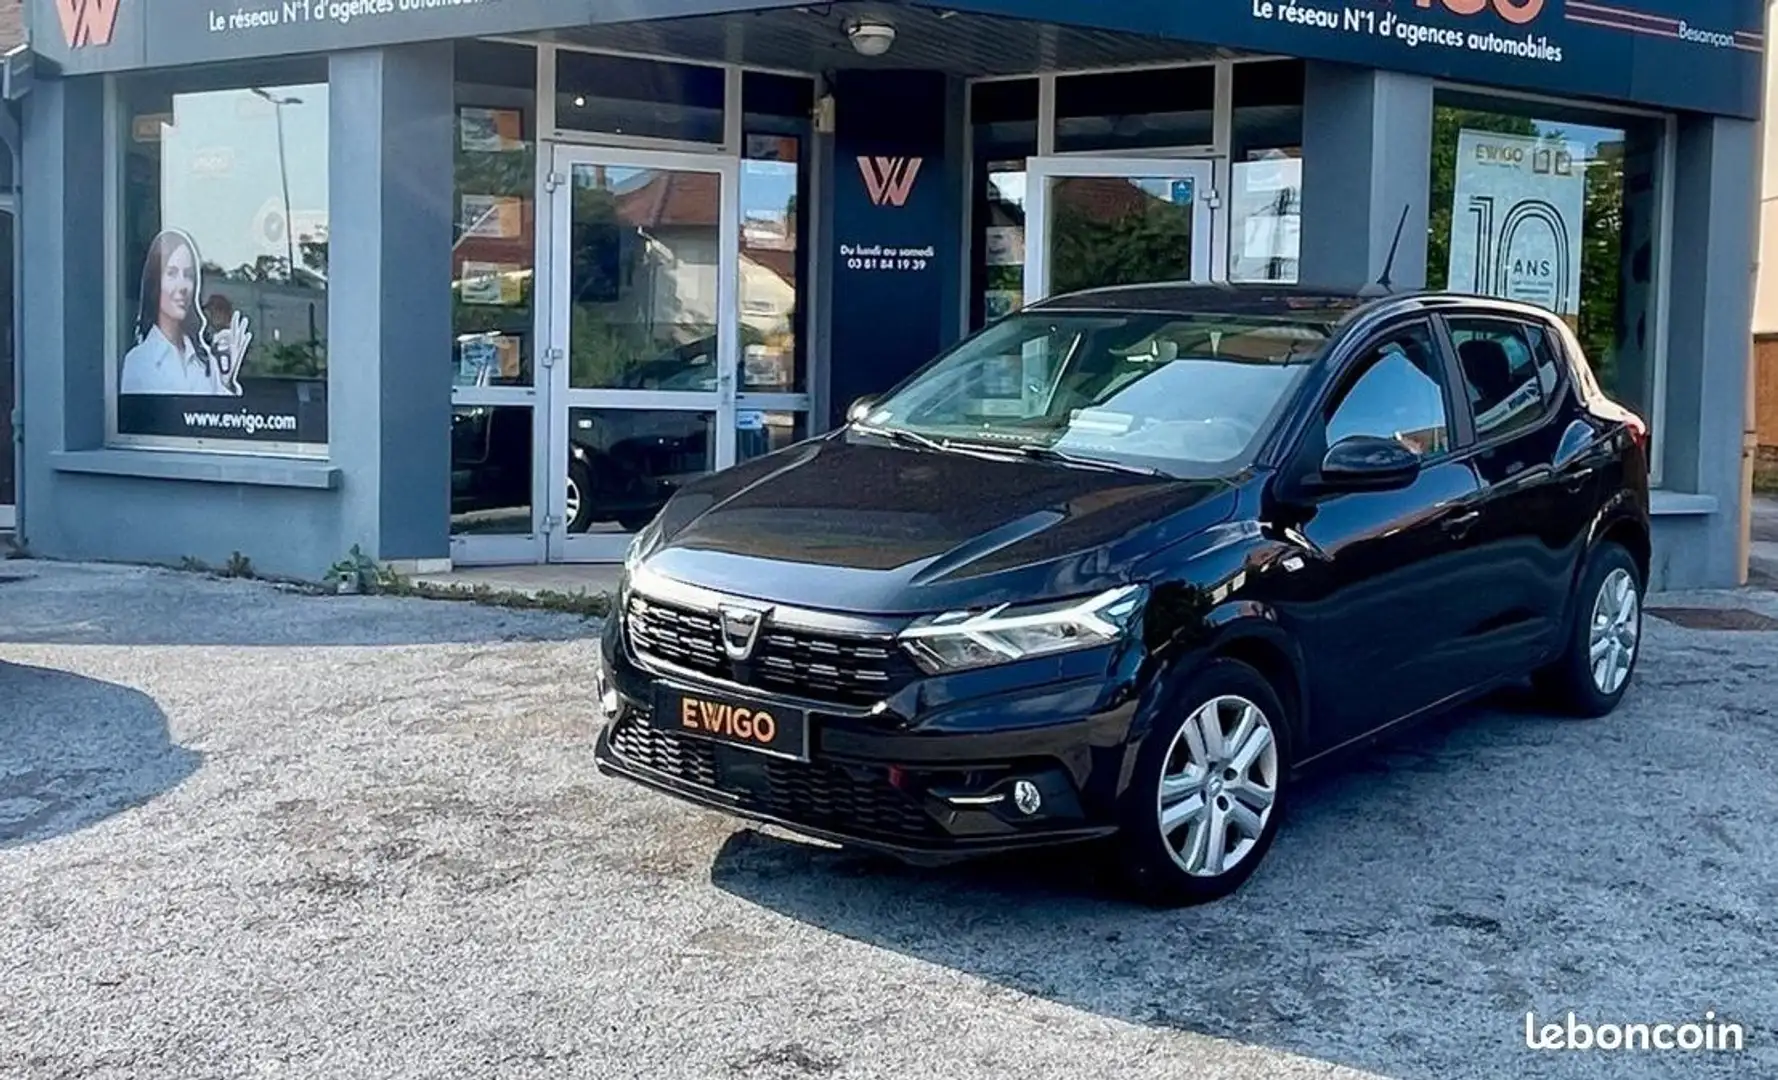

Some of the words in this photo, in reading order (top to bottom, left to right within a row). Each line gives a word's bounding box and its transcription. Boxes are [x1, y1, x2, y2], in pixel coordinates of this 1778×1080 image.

[209, 10, 226, 31] Le
[228, 8, 278, 29] réseau
[313, 0, 394, 23] d'agences
[1252, 0, 1273, 19] Le
[1278, 0, 1339, 28] réseau
[1378, 11, 1463, 47] d'agences
[1467, 34, 1562, 63] automobiles
[1679, 20, 1735, 47] Besançon
[840, 244, 855, 256] Du
[856, 243, 881, 256] lundi
[883, 247, 897, 257] au
[899, 245, 935, 257] samedi
[847, 258, 862, 270] 03
[897, 258, 911, 270] 19
[912, 259, 927, 271] 39
[1512, 259, 1550, 277] ANS
[183, 408, 297, 434] www.ewigo.com
[682, 697, 777, 744] EWIGO
